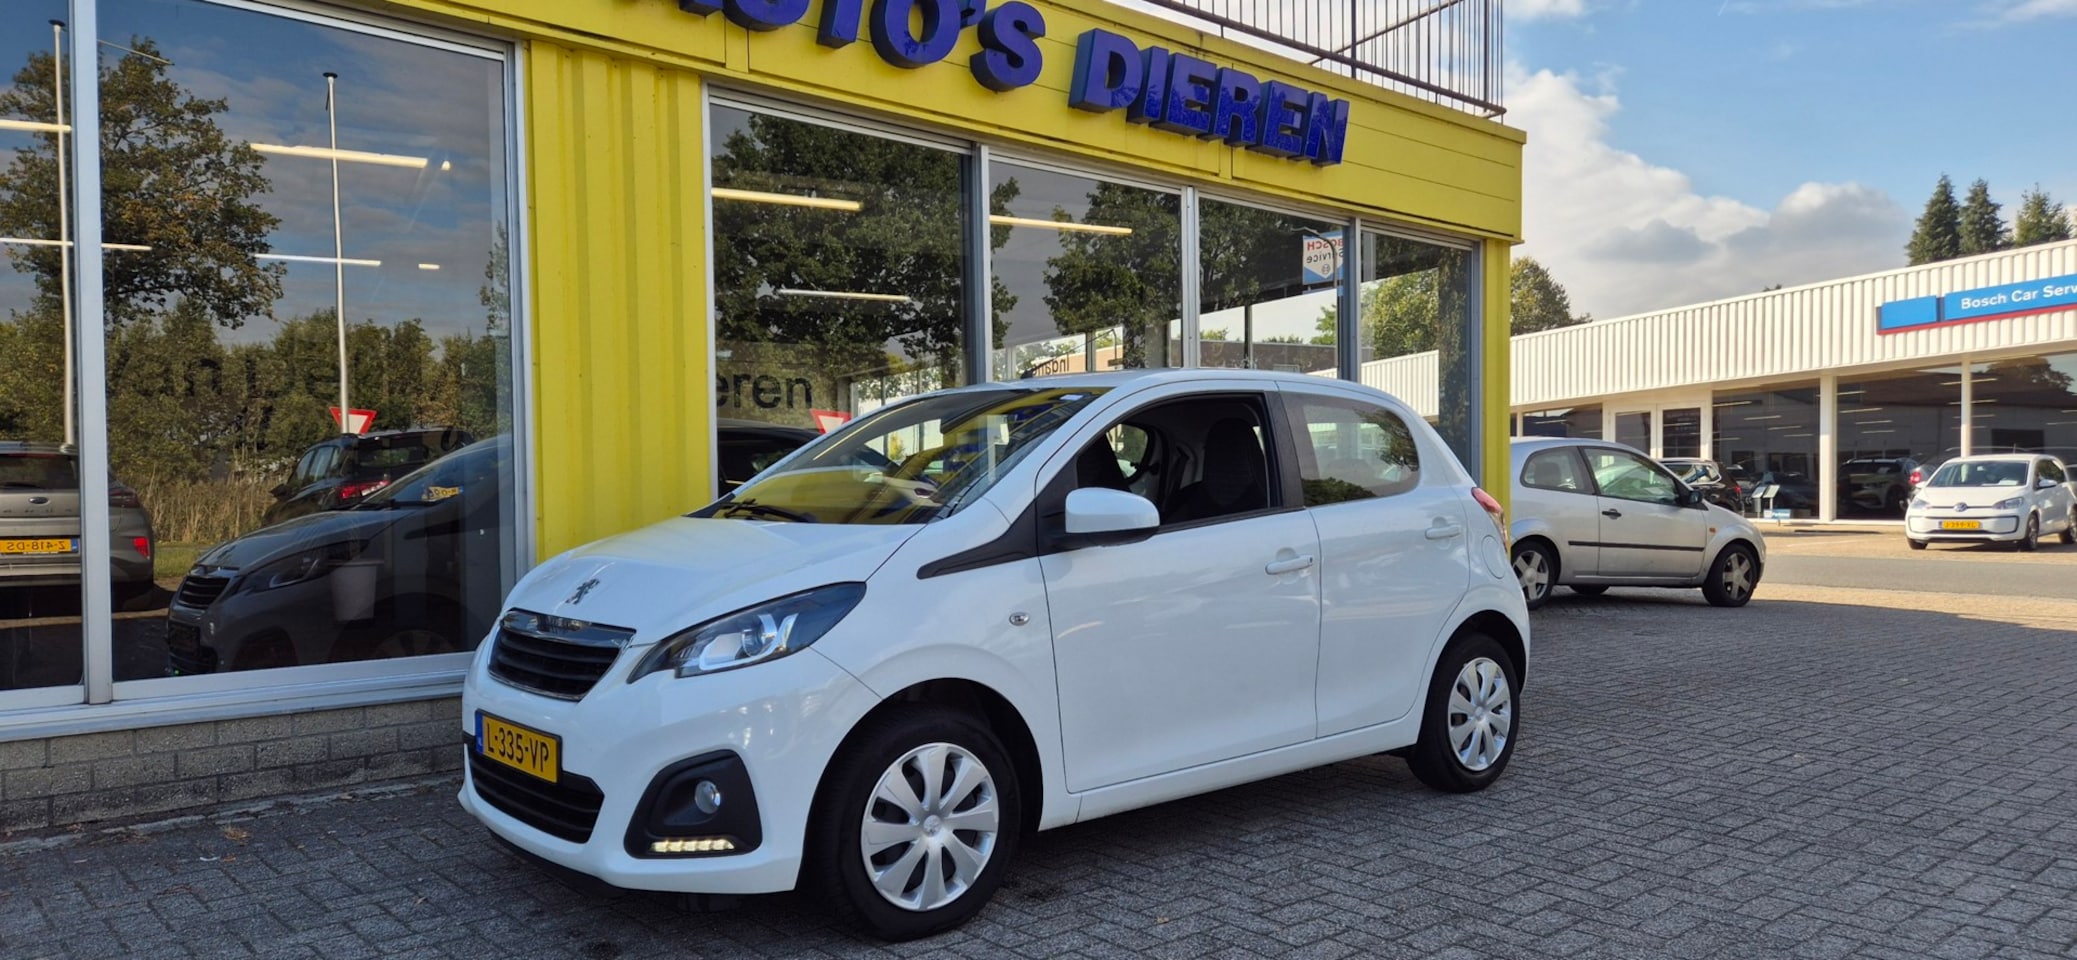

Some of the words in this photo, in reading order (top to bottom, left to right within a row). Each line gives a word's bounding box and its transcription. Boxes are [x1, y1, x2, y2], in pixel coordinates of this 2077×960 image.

[1069, 27, 1350, 166] DIEREN
[1961, 293, 2007, 310] Bosch
[2011, 289, 2038, 302] Car
[486, 722, 549, 773] L-335-VP
